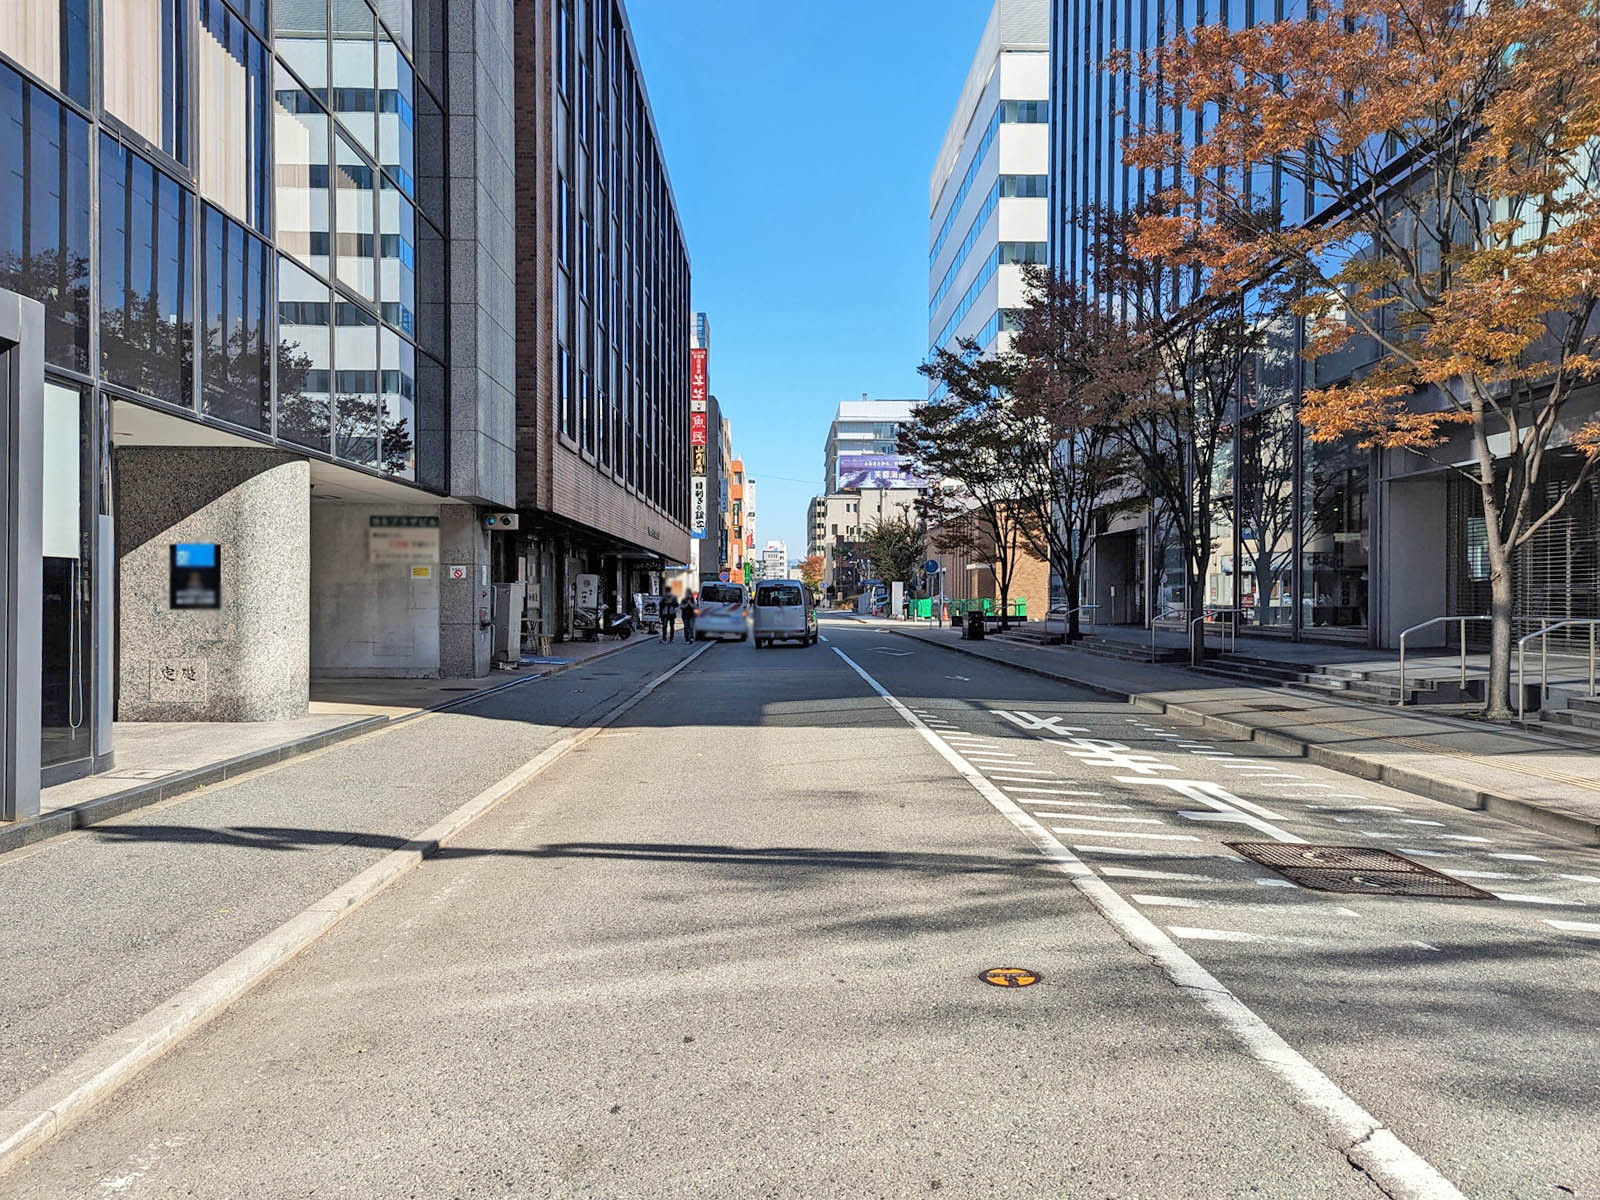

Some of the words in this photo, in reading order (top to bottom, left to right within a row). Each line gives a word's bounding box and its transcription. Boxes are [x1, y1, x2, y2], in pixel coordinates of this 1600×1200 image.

[691, 415, 705, 443] 魚民
[695, 481, 704, 528] 目利きの銀次
[161, 665, 196, 682] 定礎
